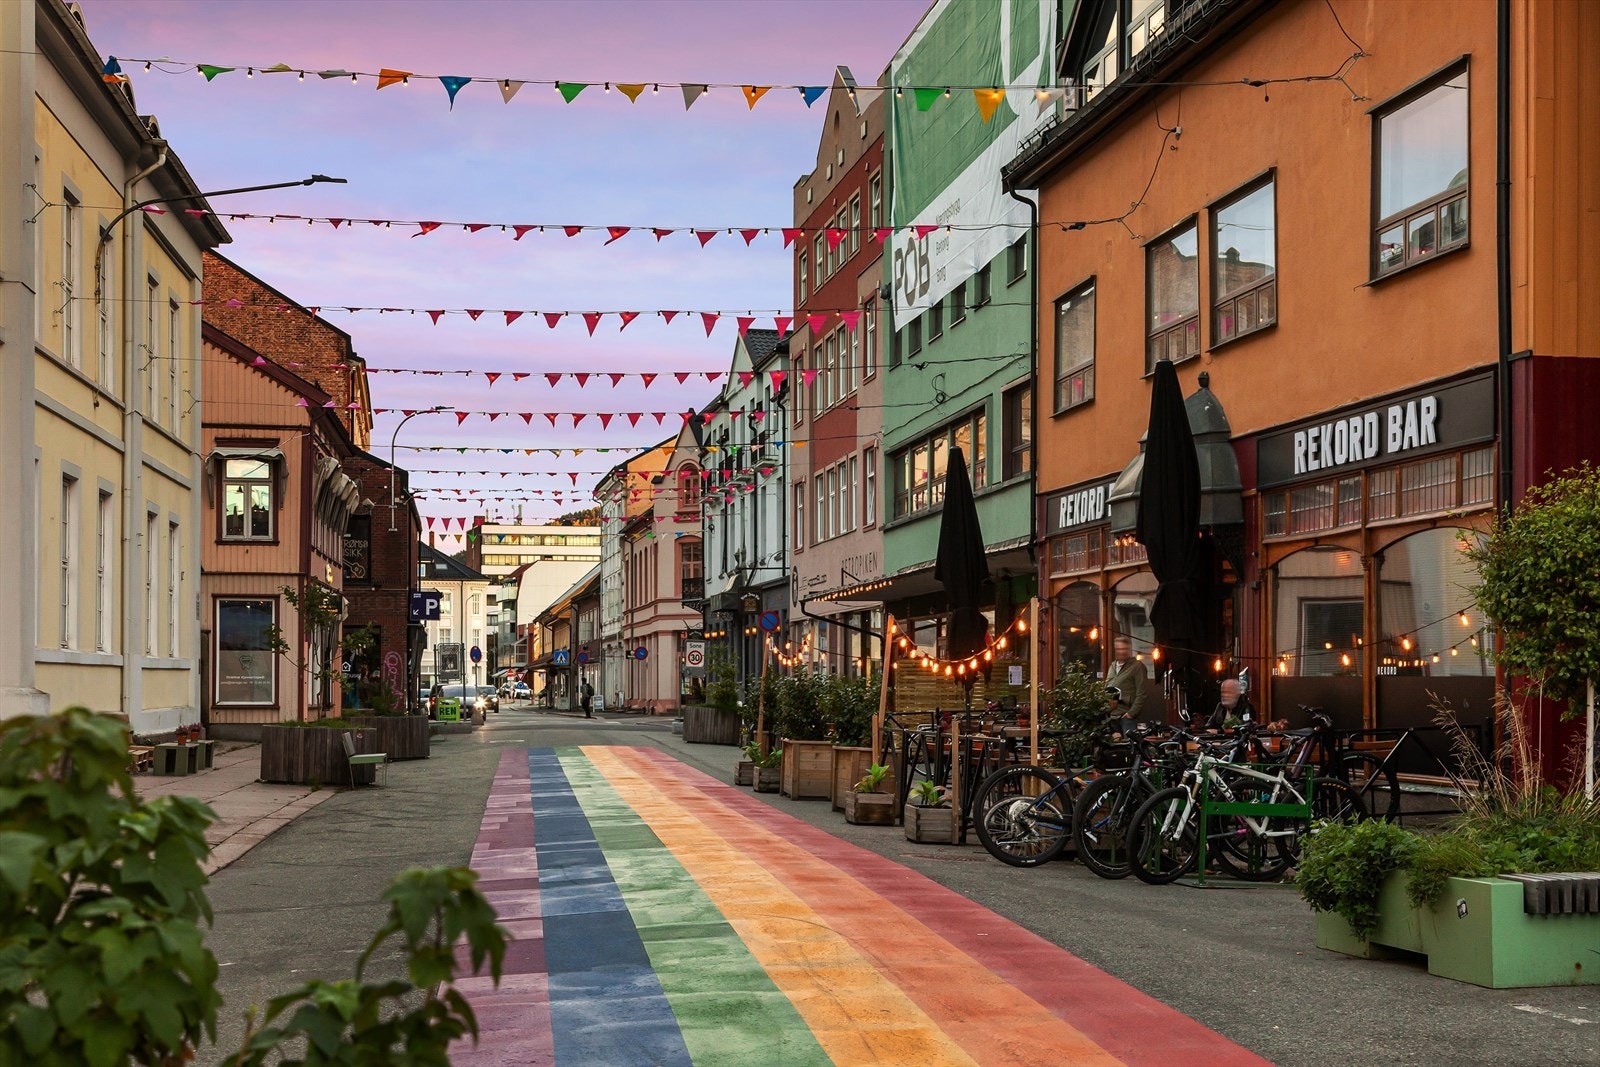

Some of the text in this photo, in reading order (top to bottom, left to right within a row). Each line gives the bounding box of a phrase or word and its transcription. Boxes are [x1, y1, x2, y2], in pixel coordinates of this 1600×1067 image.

[894, 232, 931, 316] POB
[1294, 395, 1438, 475] REKORD BAR
[1059, 485, 1105, 529] REKORD
[425, 598, 439, 616] P
[690, 653, 700, 662] 30
[1376, 666, 1397, 675] REKORD
[439, 707, 456, 716] REN
